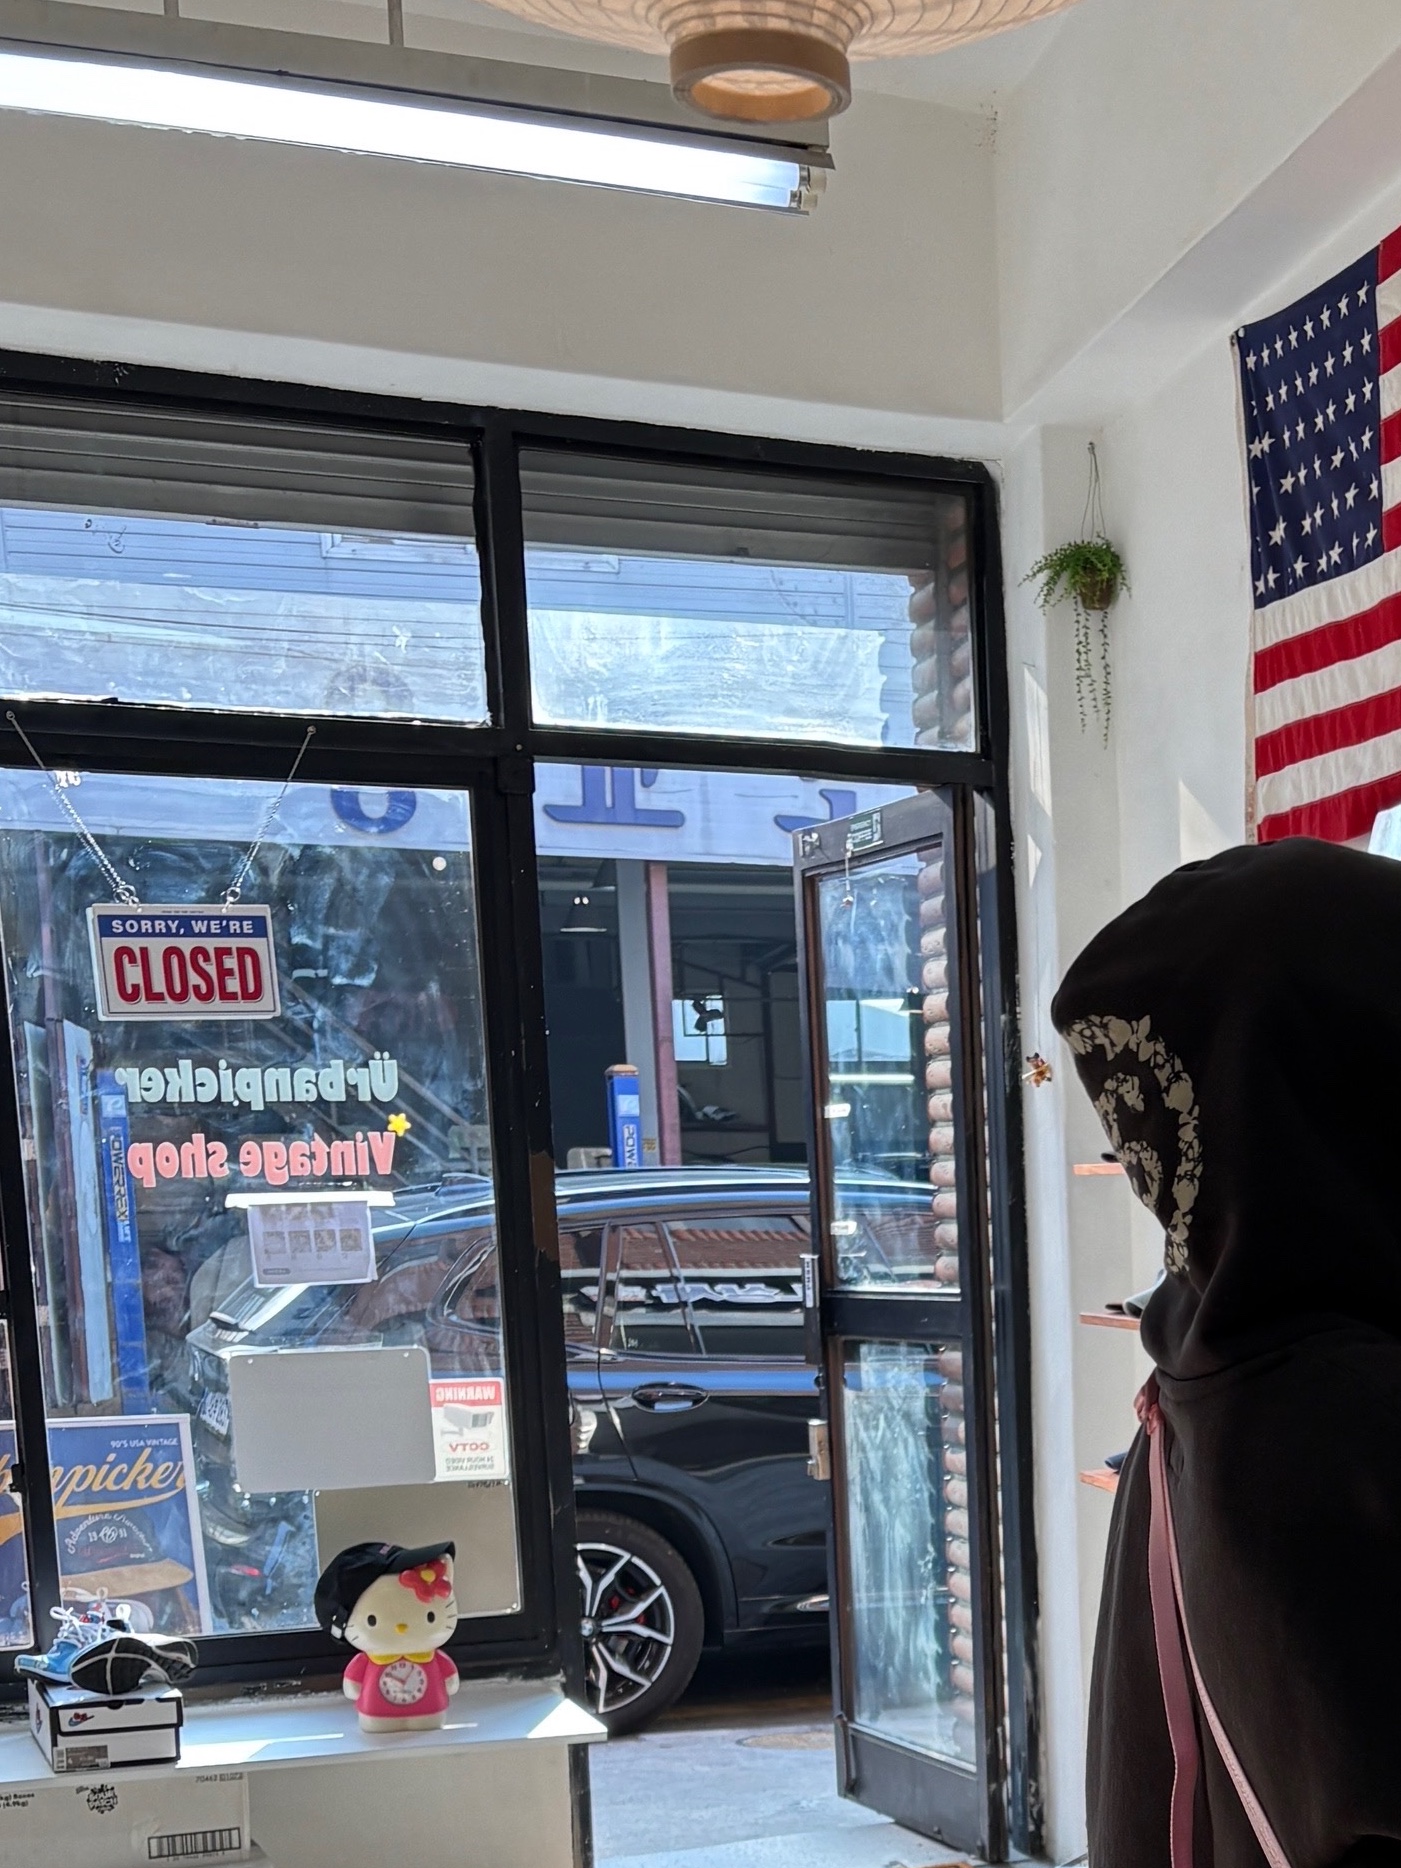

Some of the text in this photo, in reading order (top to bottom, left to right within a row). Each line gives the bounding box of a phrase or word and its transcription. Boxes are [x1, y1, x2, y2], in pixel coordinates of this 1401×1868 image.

[112, 919, 254, 935] SORRY, WE'RE
[113, 945, 265, 1004] CLOSED
[145, 1438, 178, 1447] VINTAGE
